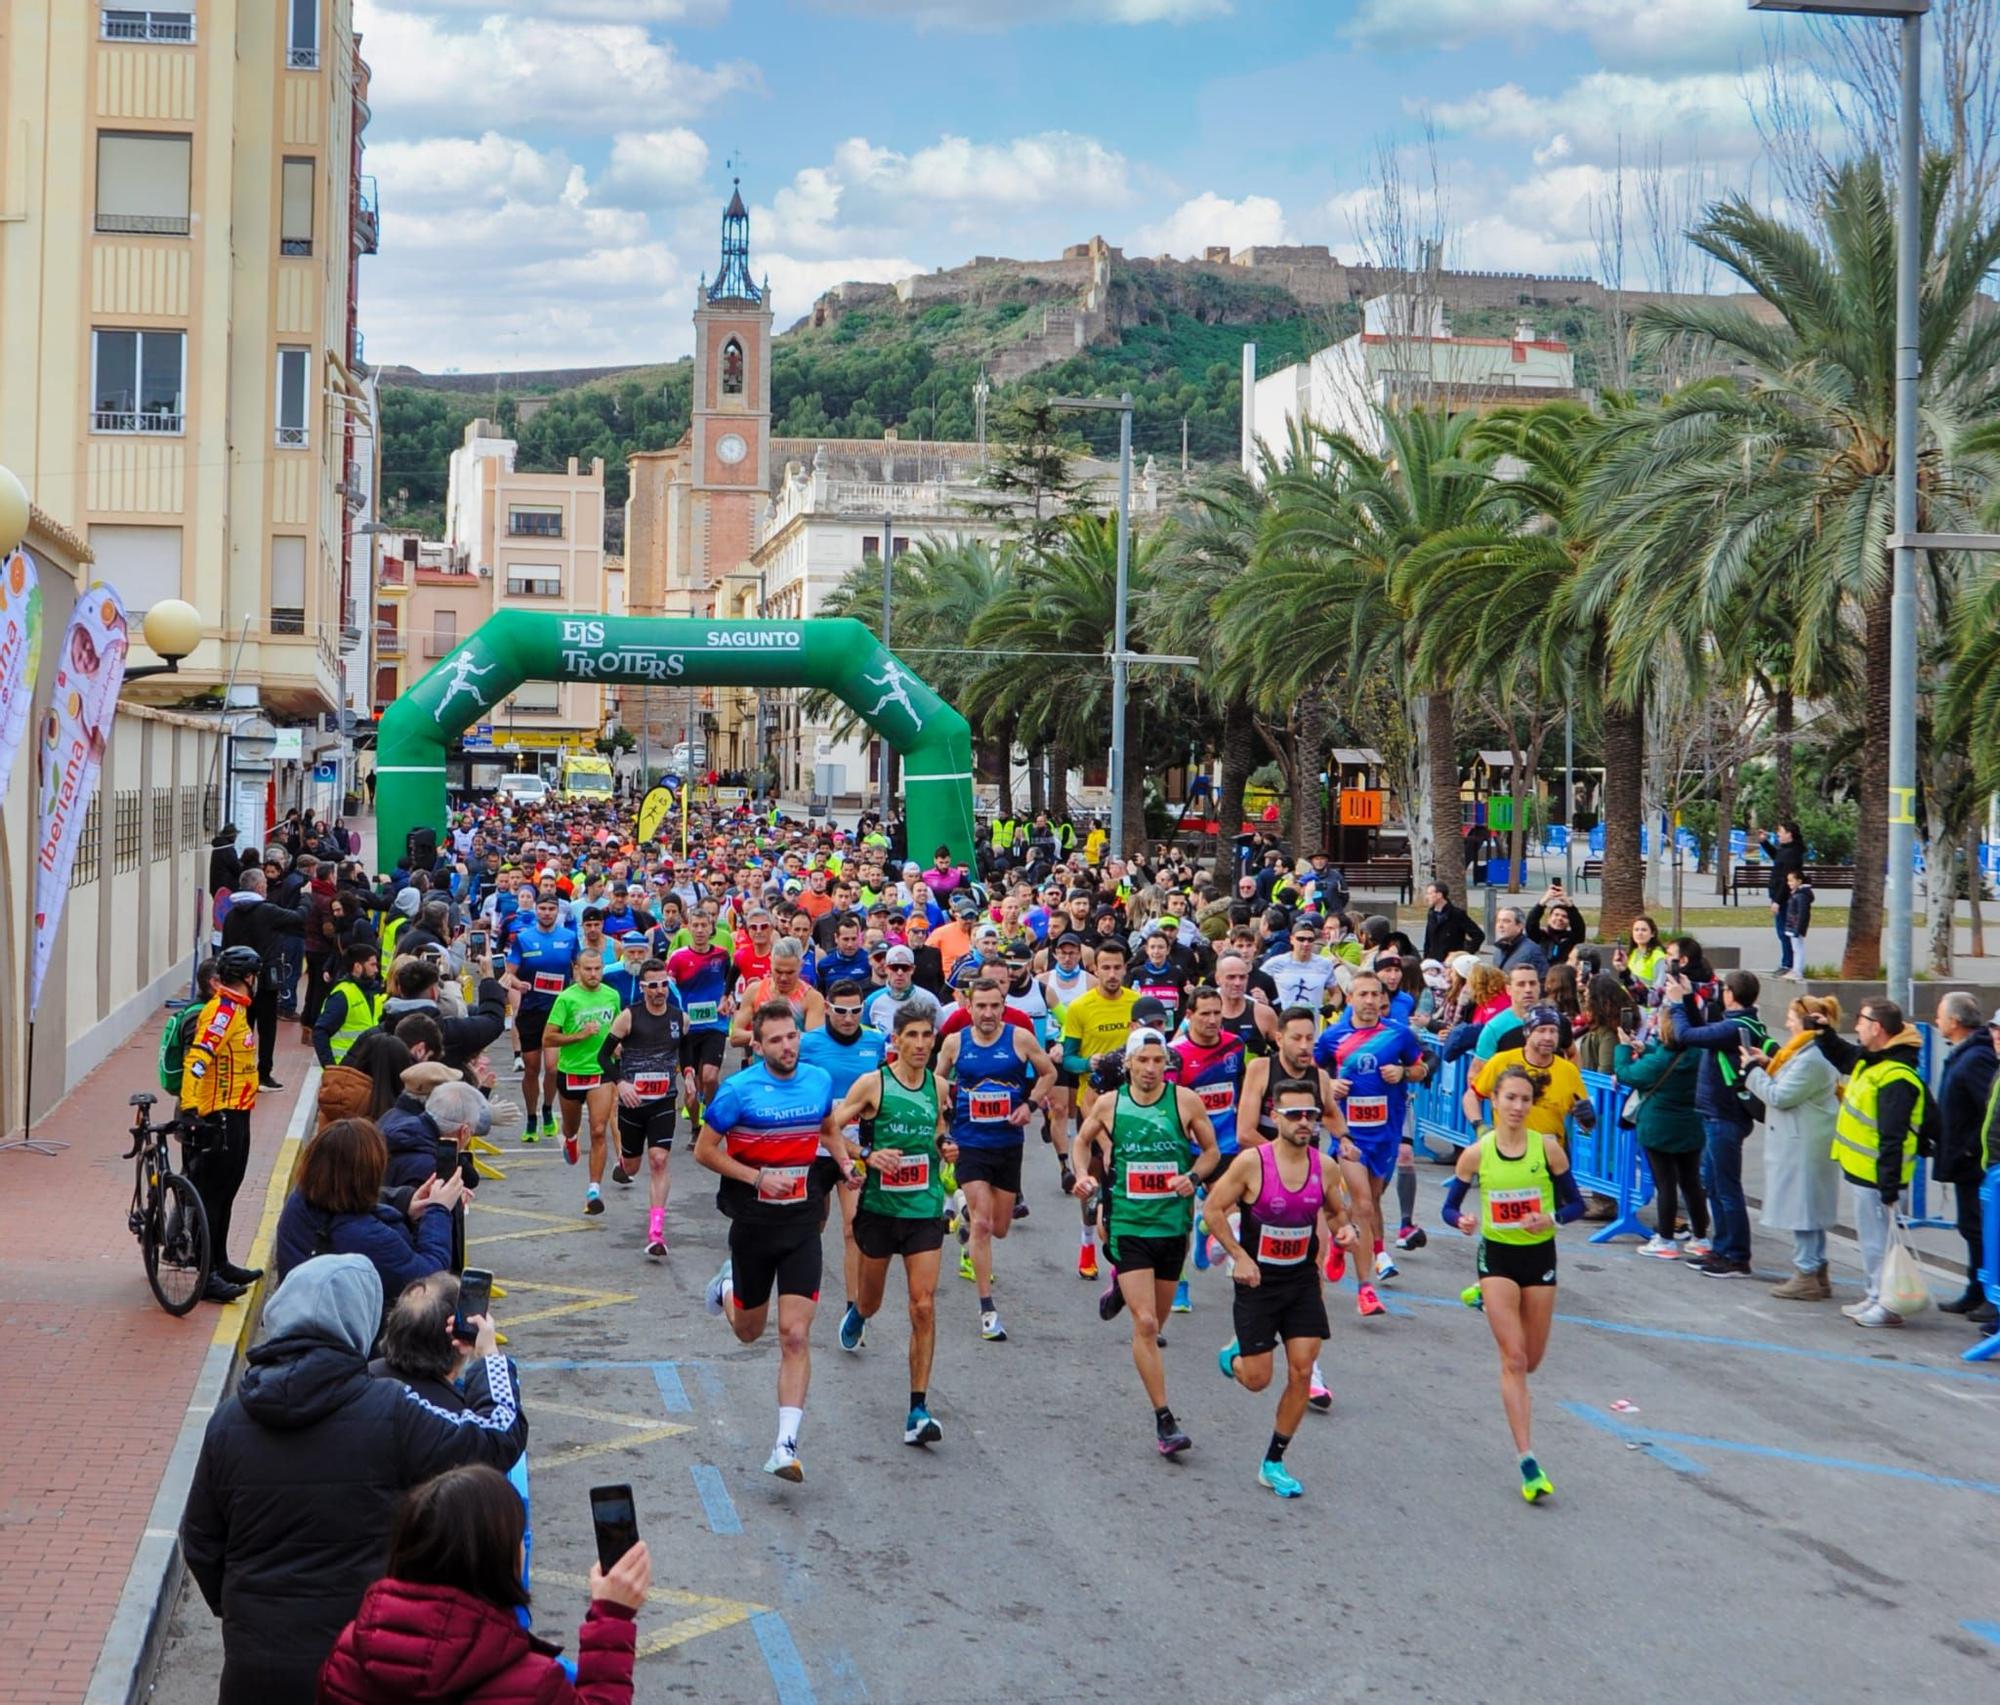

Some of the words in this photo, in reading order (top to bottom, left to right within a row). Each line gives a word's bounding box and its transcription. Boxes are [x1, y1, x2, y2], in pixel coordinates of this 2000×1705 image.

[562, 621, 605, 648] ELS
[706, 631, 800, 646] SAGUNTO
[562, 650, 684, 679] TROTERS
[979, 1101, 1001, 1115] 410
[1355, 1105, 1380, 1119] 393
[1139, 1174, 1166, 1190] 148
[1499, 1201, 1532, 1219] 395
[1270, 1239, 1302, 1255] 380
